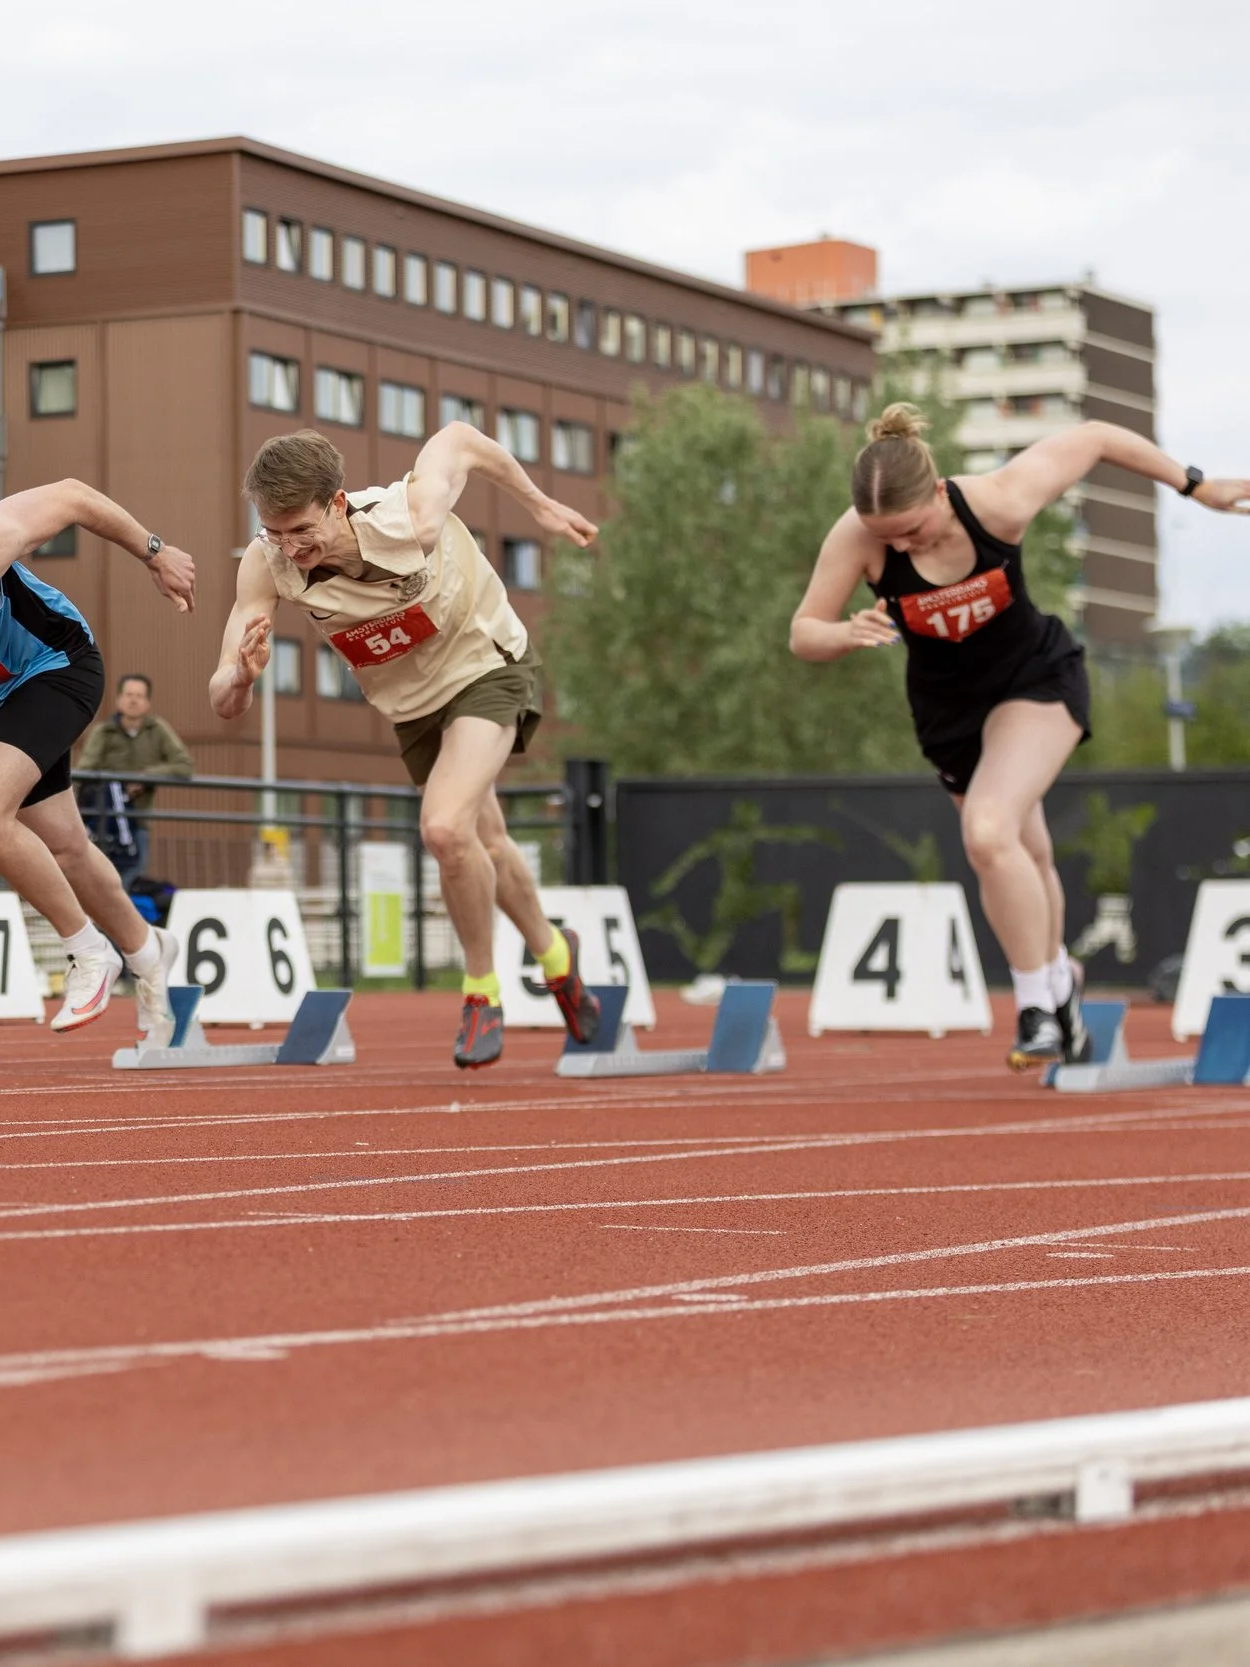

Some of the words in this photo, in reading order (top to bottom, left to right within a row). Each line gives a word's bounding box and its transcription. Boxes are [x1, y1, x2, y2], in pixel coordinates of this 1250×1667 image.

[345, 611, 406, 639] AMSTERDAMS
[365, 626, 412, 655] 54
[926, 596, 995, 637] 175
[186, 917, 227, 996] 6
[267, 917, 294, 995] 6
[603, 917, 630, 986] 5
[852, 918, 901, 999] 4
[949, 918, 969, 999] 4
